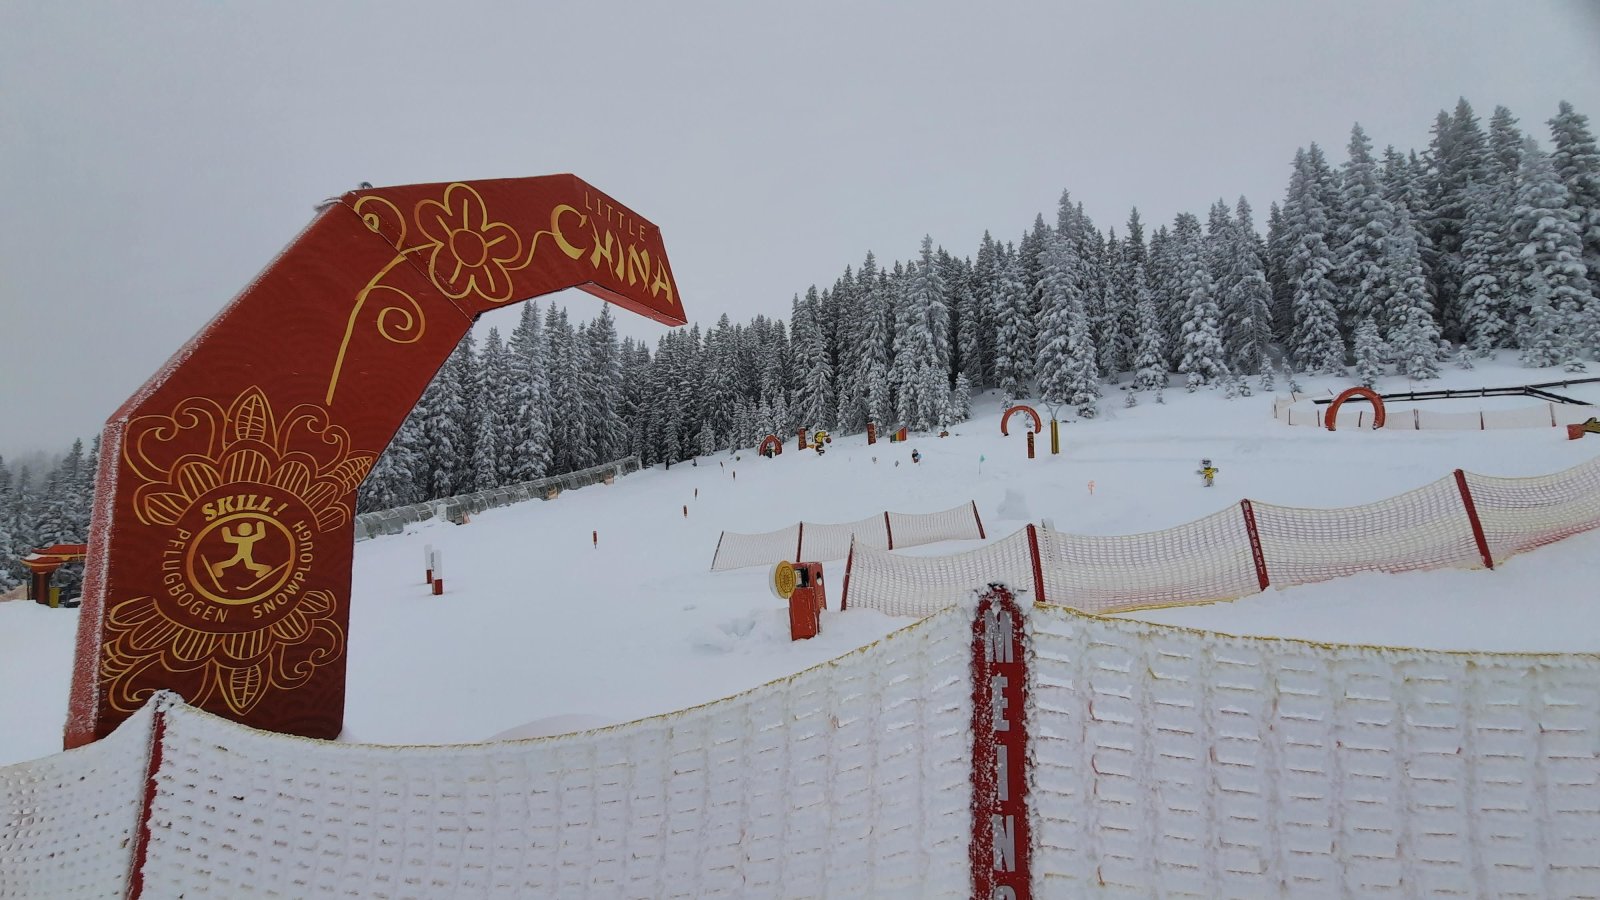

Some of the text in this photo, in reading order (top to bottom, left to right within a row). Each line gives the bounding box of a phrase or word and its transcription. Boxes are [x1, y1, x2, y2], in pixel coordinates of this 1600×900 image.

[550, 204, 674, 306] CHINA
[585, 191, 646, 242] LITTLE
[201, 494, 289, 522] SKILL!
[162, 527, 229, 623] PFLUGBOGEN
[252, 520, 314, 619] SNOWPLOUGH
[984, 609, 1016, 900] MEIN
